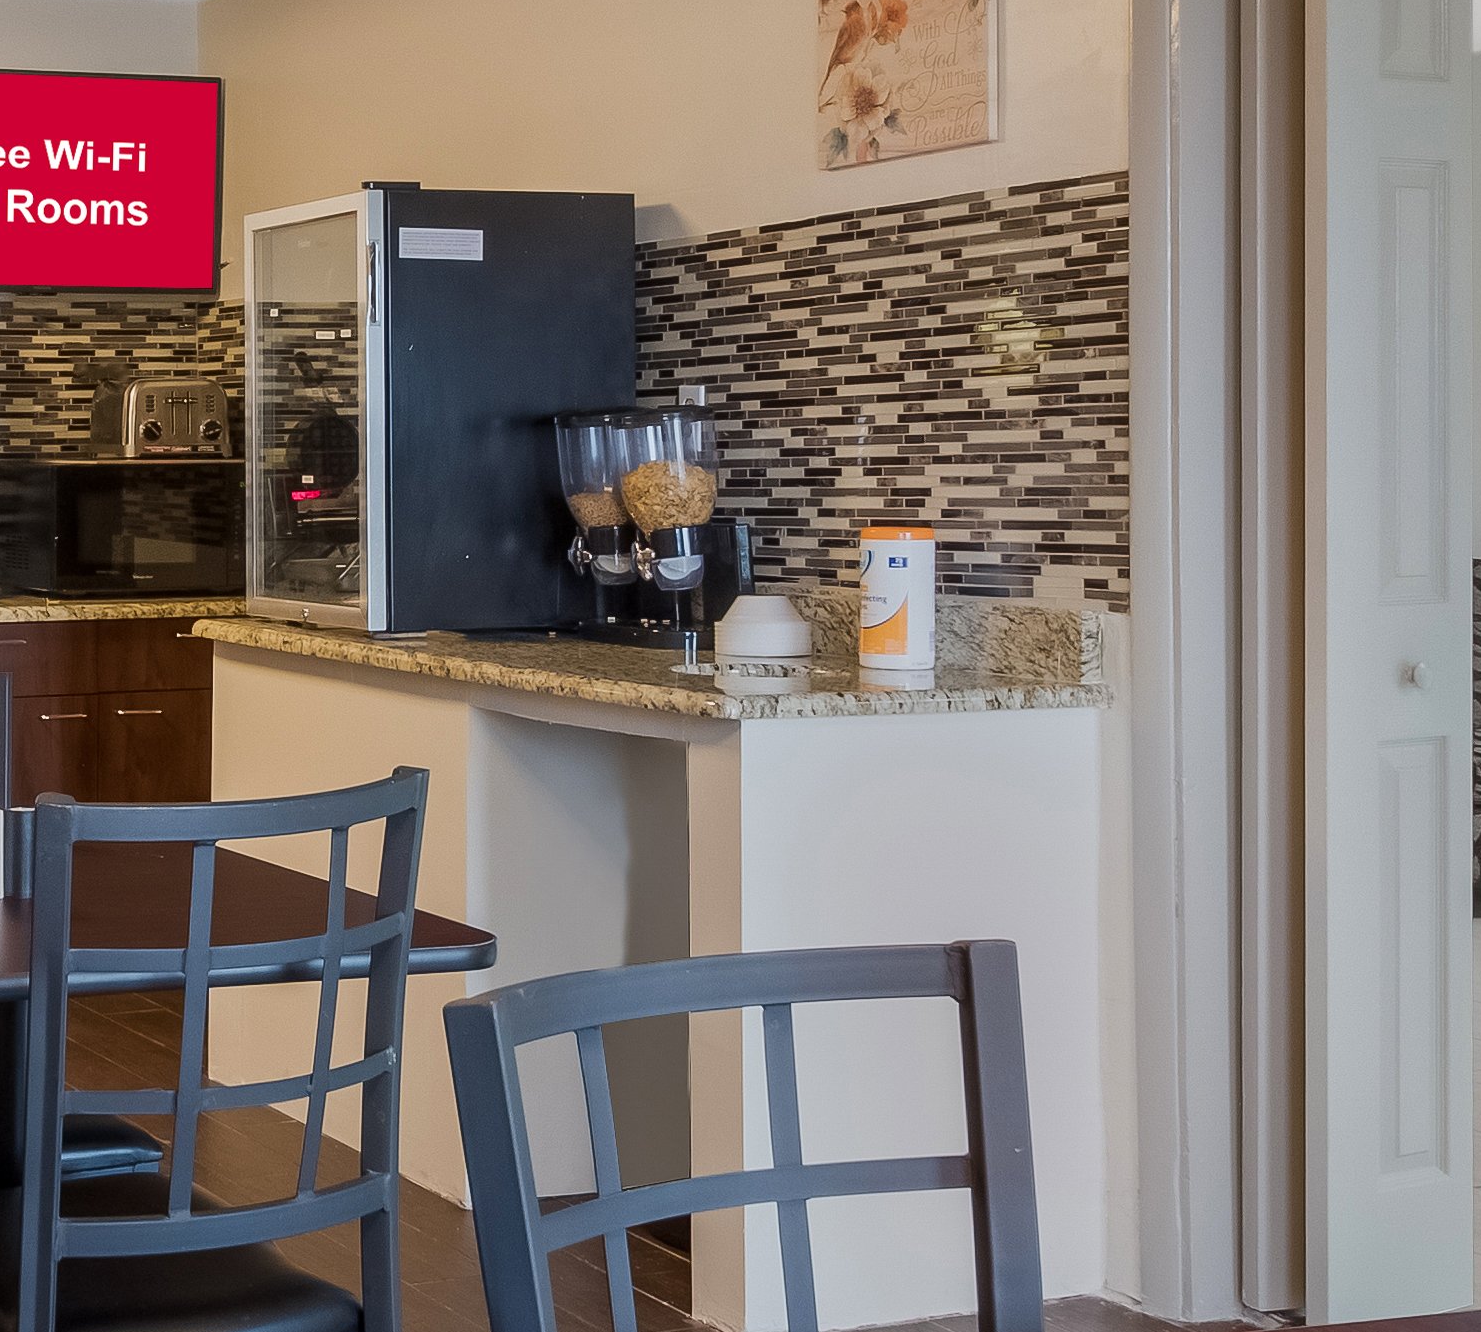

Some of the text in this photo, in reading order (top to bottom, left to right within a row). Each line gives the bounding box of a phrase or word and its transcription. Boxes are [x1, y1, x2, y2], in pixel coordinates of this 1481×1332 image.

[913, 19, 941, 42] With
[940, 69, 987, 93] All Things
[906, 101, 987, 147] Possible
[44, 139, 147, 172] Wi-Fi
[7, 188, 149, 227] Rooms
